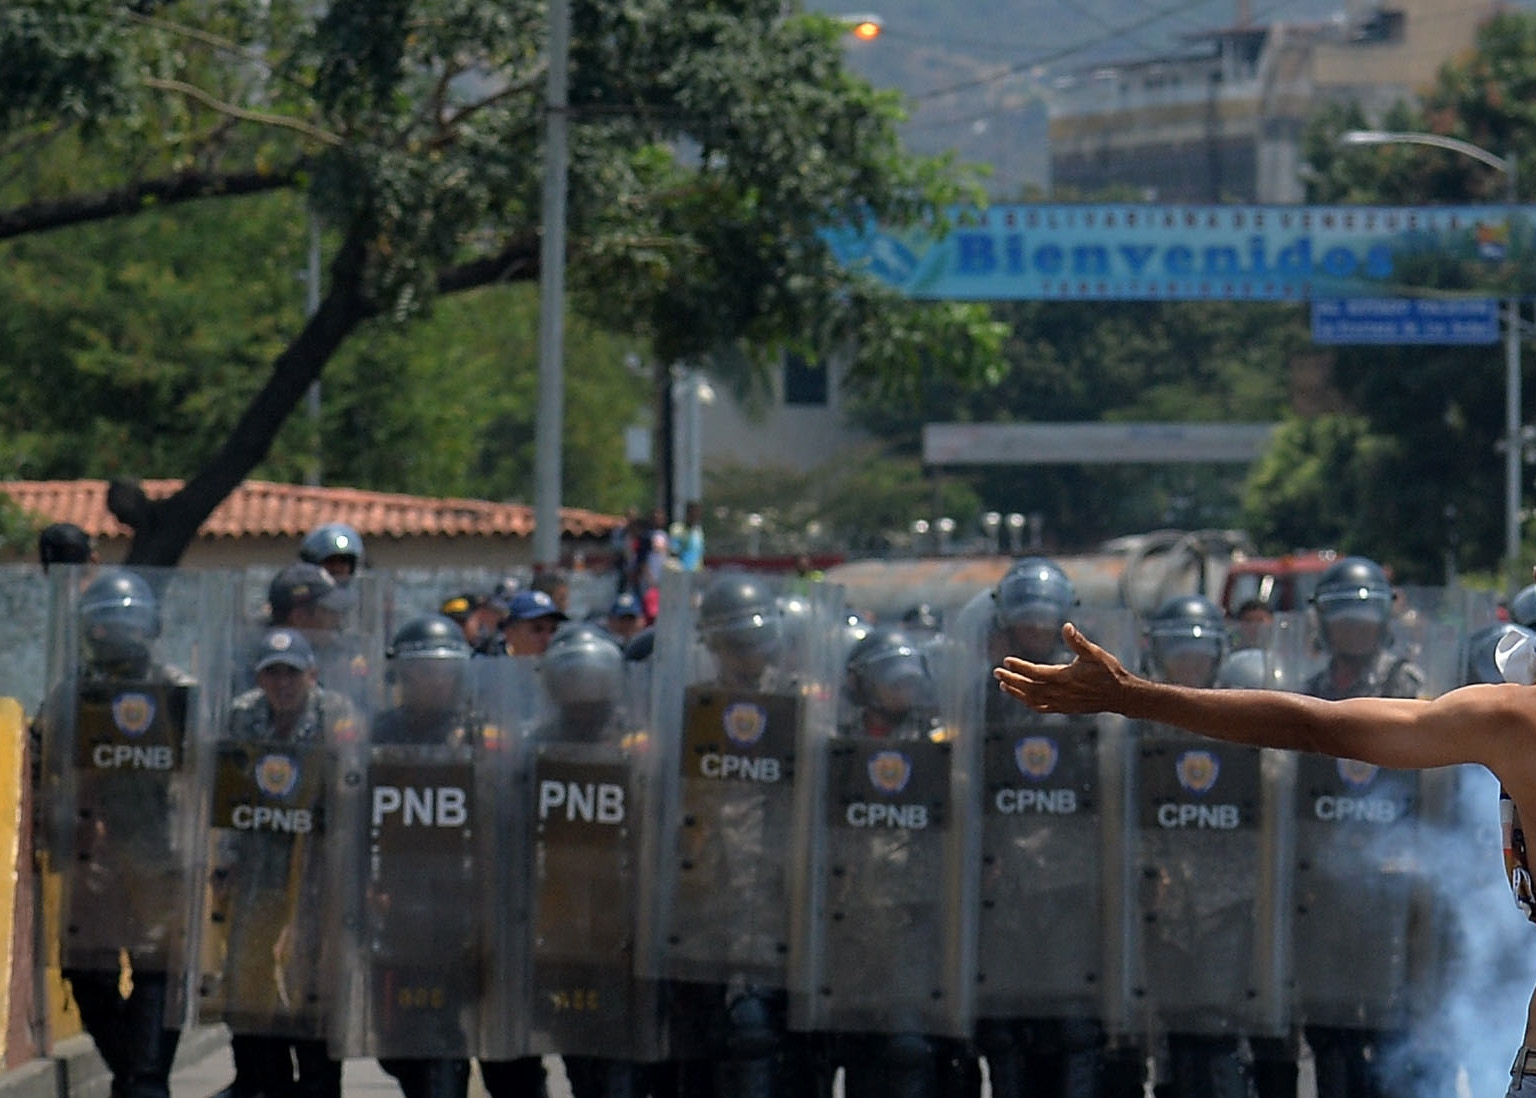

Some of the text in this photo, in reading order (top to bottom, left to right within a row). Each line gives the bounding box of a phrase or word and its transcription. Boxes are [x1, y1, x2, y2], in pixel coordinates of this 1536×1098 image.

[957, 233, 1395, 279] Bienvenidos
[92, 743, 174, 770] CPNB
[699, 753, 781, 783] CPNB
[371, 785, 469, 827] PNB
[538, 780, 626, 825] PNB
[846, 801, 928, 830] CPNB
[995, 788, 1078, 814] CPNB
[1314, 795, 1397, 823] CPNB
[231, 804, 313, 833] CPNB
[1157, 803, 1240, 830] CPNB
